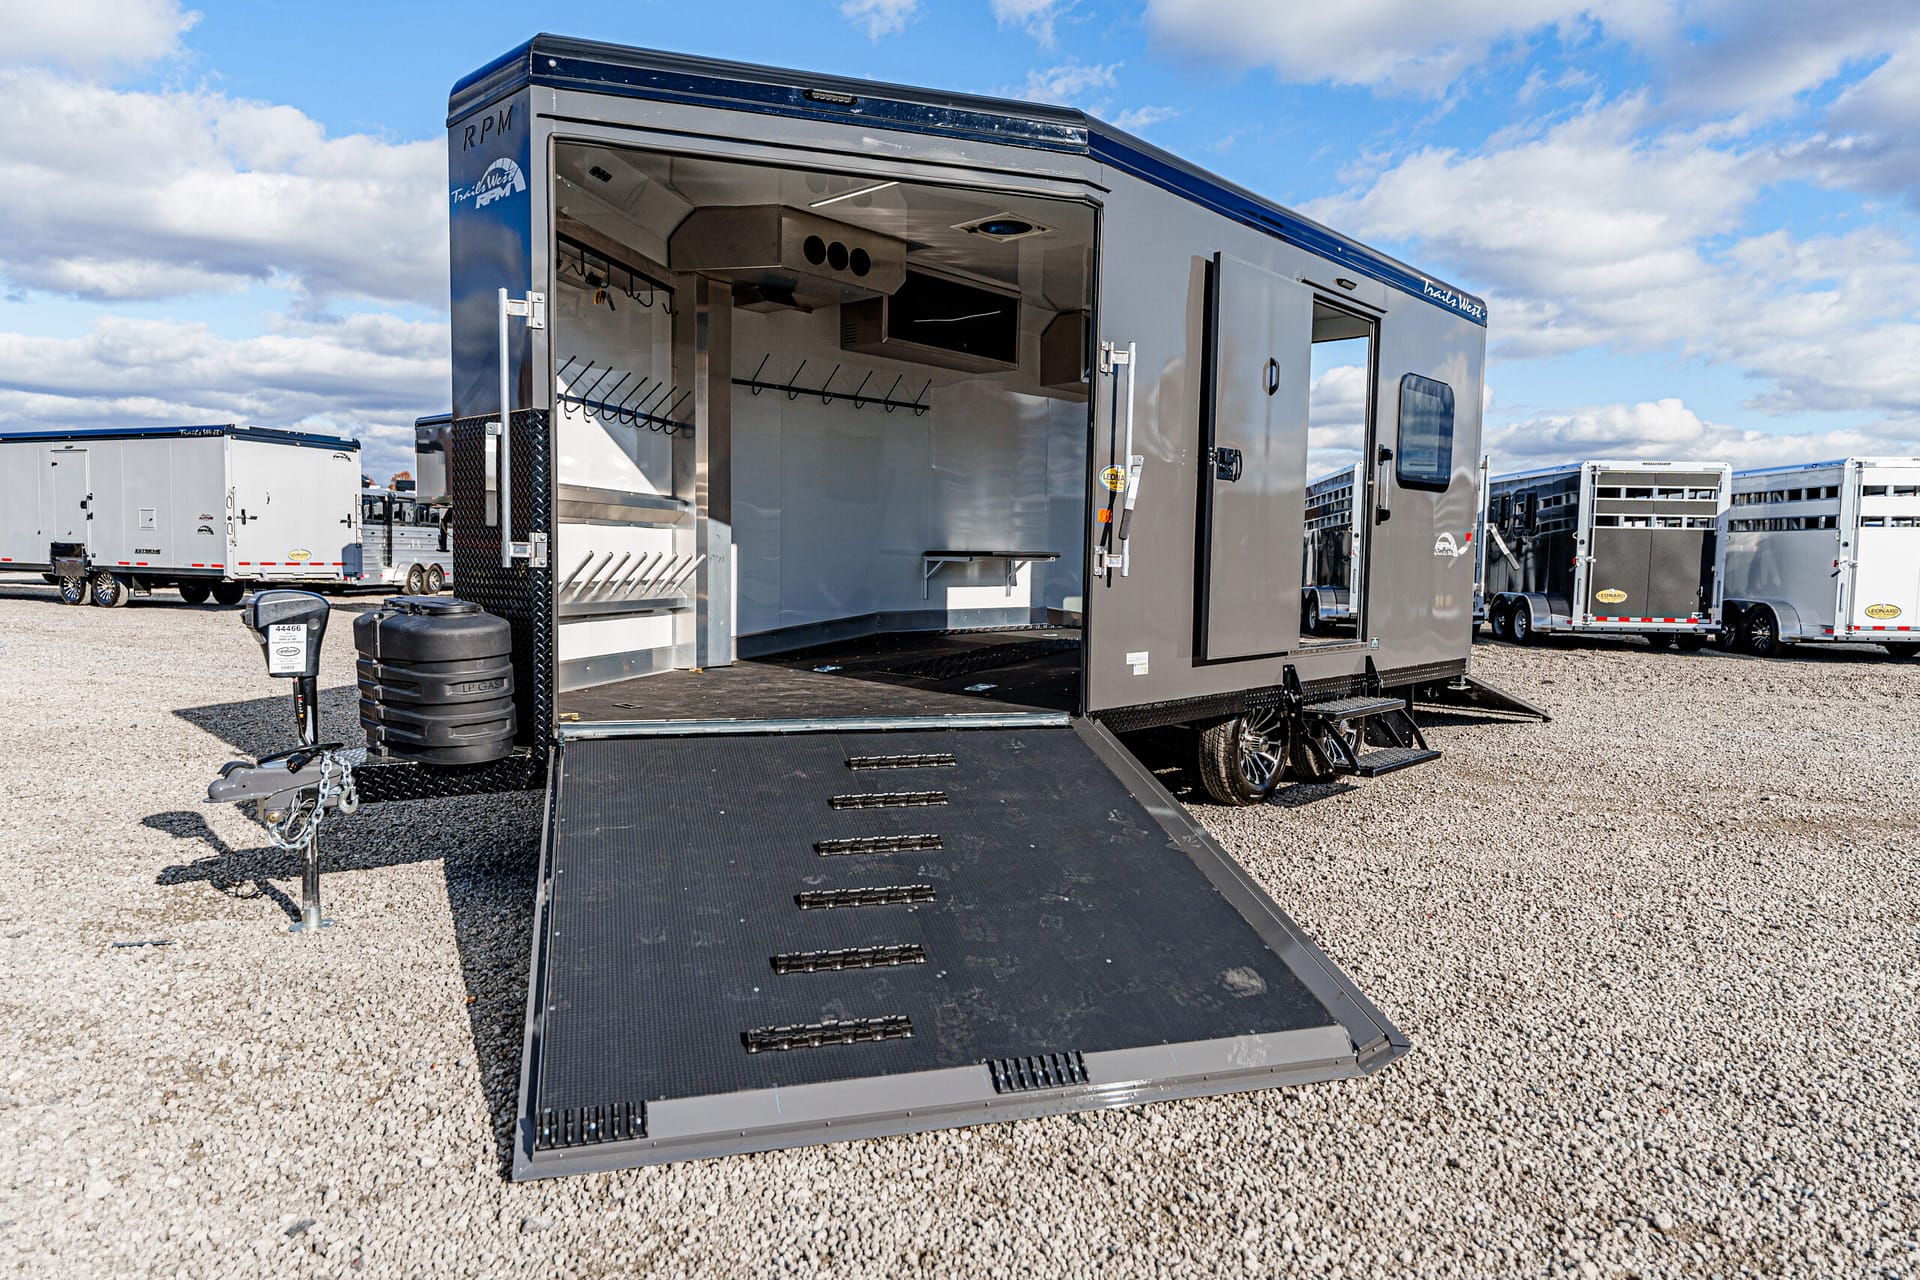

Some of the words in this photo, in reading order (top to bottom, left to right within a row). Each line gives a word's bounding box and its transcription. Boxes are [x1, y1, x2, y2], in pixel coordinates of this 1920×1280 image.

[462, 102, 513, 152] RPM
[450, 181, 487, 204] Trails
[486, 167, 517, 190] West
[475, 181, 516, 209] RPM
[1420, 276, 1457, 308] Trails
[1458, 293, 1482, 318] West
[462, 683, 475, 693] LP
[478, 679, 500, 691] GAS
